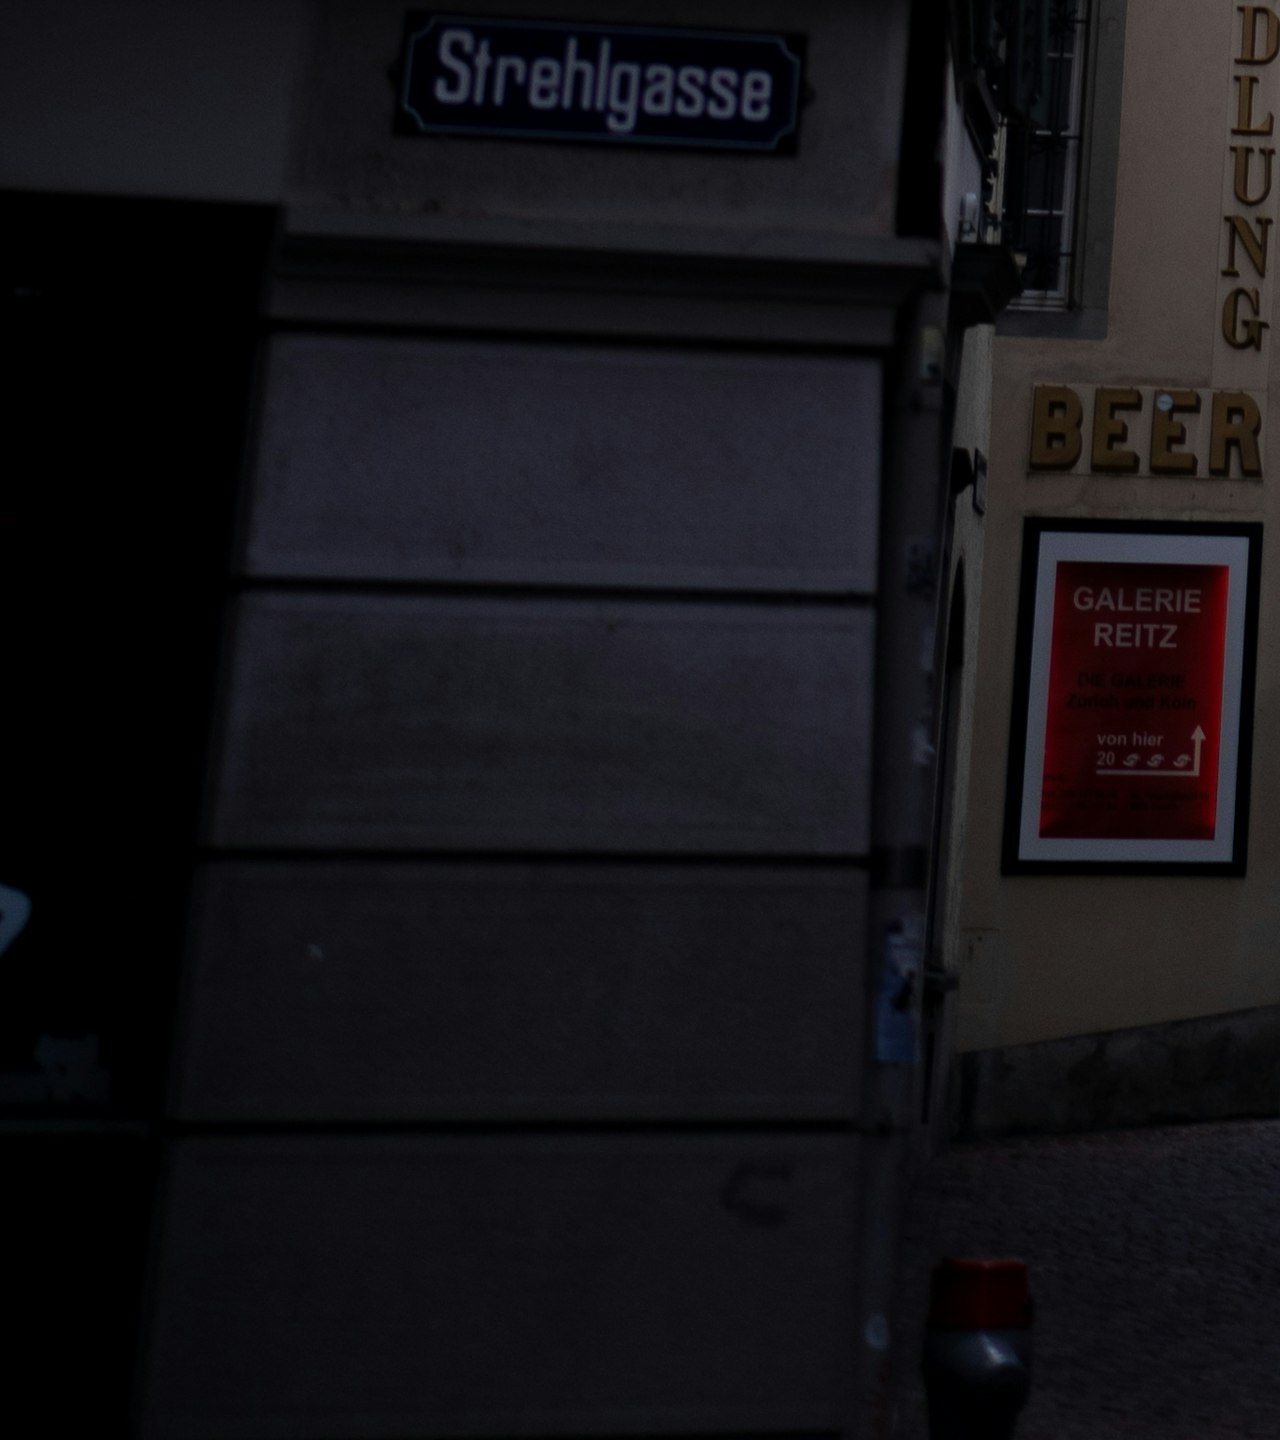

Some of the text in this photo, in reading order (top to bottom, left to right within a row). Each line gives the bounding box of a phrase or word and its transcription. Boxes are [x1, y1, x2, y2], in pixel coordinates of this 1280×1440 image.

[434, 28, 773, 134] Strehlgasse
[1028, 383, 1264, 478] BEER
[1073, 585, 1202, 614] GALERIE
[1093, 622, 1178, 649] REITZ
[1077, 671, 1186, 689] DIE GALERIE
[1066, 691, 1197, 711] Zürich und Köln
[1097, 732, 1164, 748] von hier
[1096, 752, 1116, 767] 20
